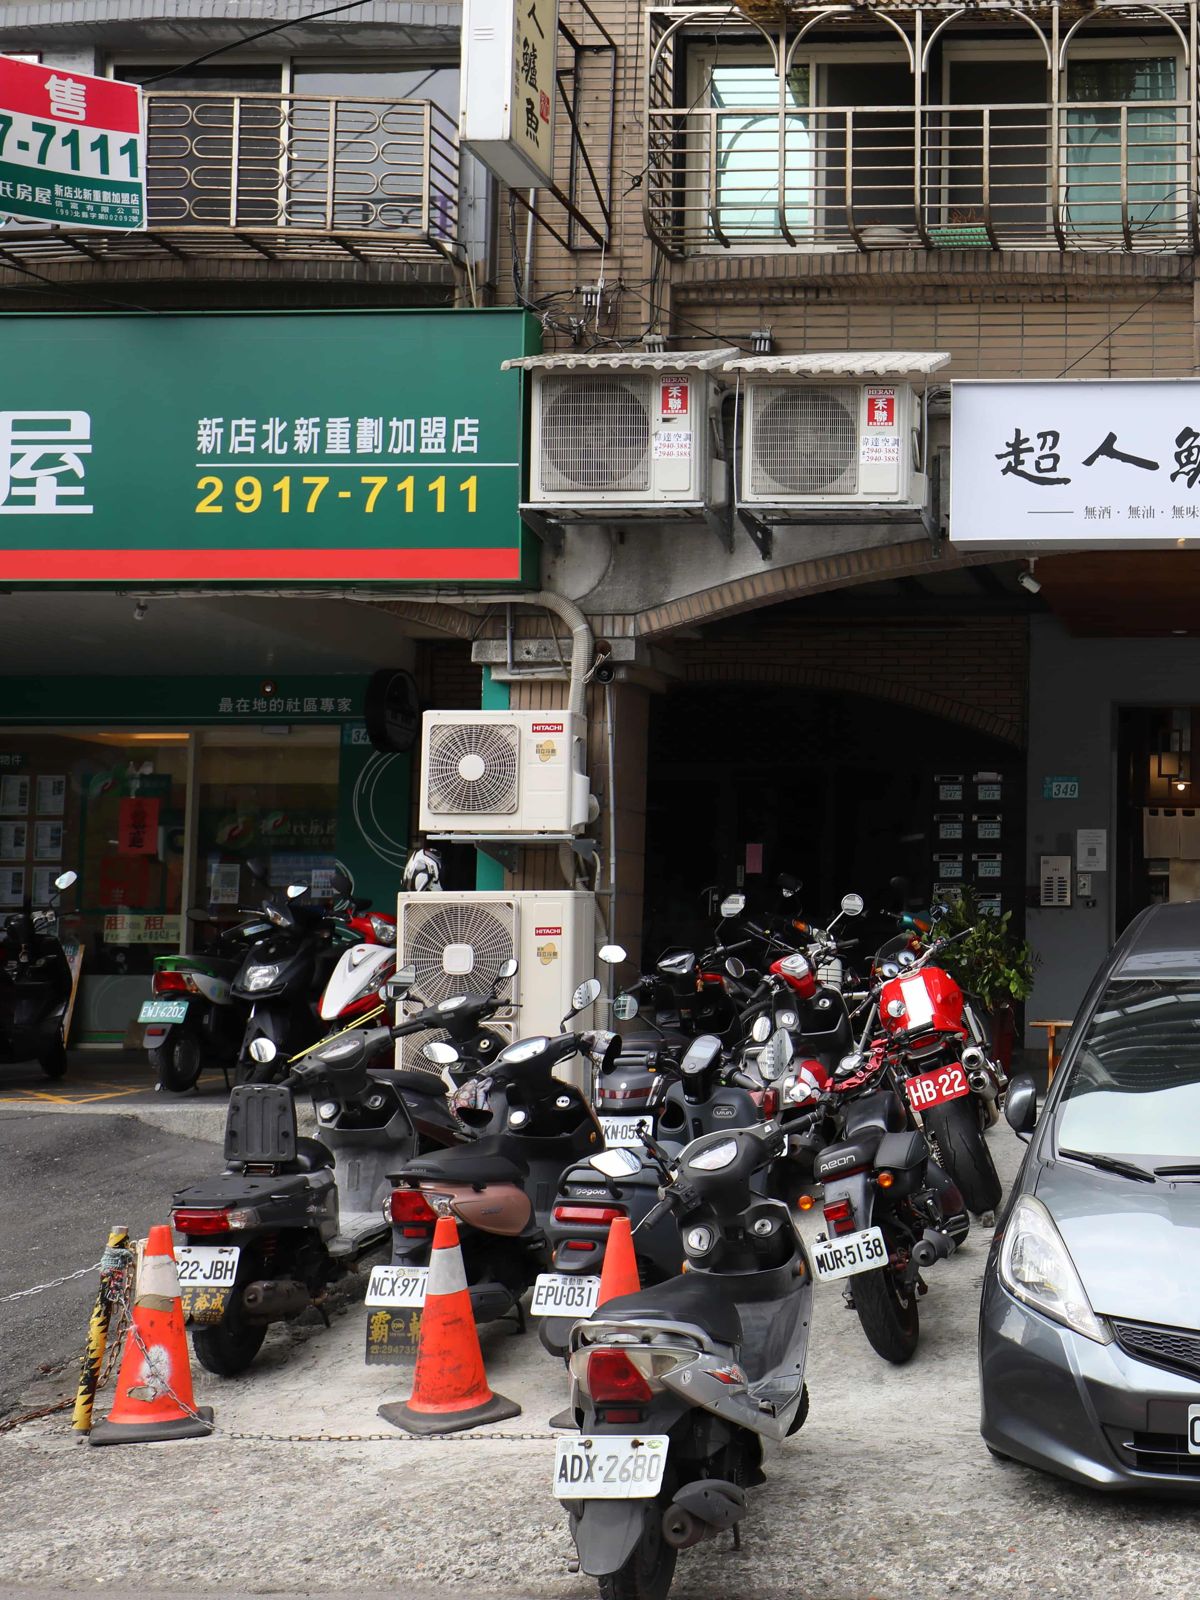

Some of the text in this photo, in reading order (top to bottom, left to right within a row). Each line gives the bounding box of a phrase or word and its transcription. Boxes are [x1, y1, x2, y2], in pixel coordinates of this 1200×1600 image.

[44, 74, 87, 121] 售
[668, 386, 682, 411] 禾聯
[874, 398, 888, 422] 禾聯
[197, 416, 480, 454] 新店北新重劃加盟店
[0, 410, 93, 514] 屋
[195, 475, 478, 513] 2917-7111
[219, 697, 352, 713] 最在地的社區專家
[353, 730, 372, 743] 34
[1054, 783, 1077, 797] 349
[576, 1188, 607, 1196] gogoro
